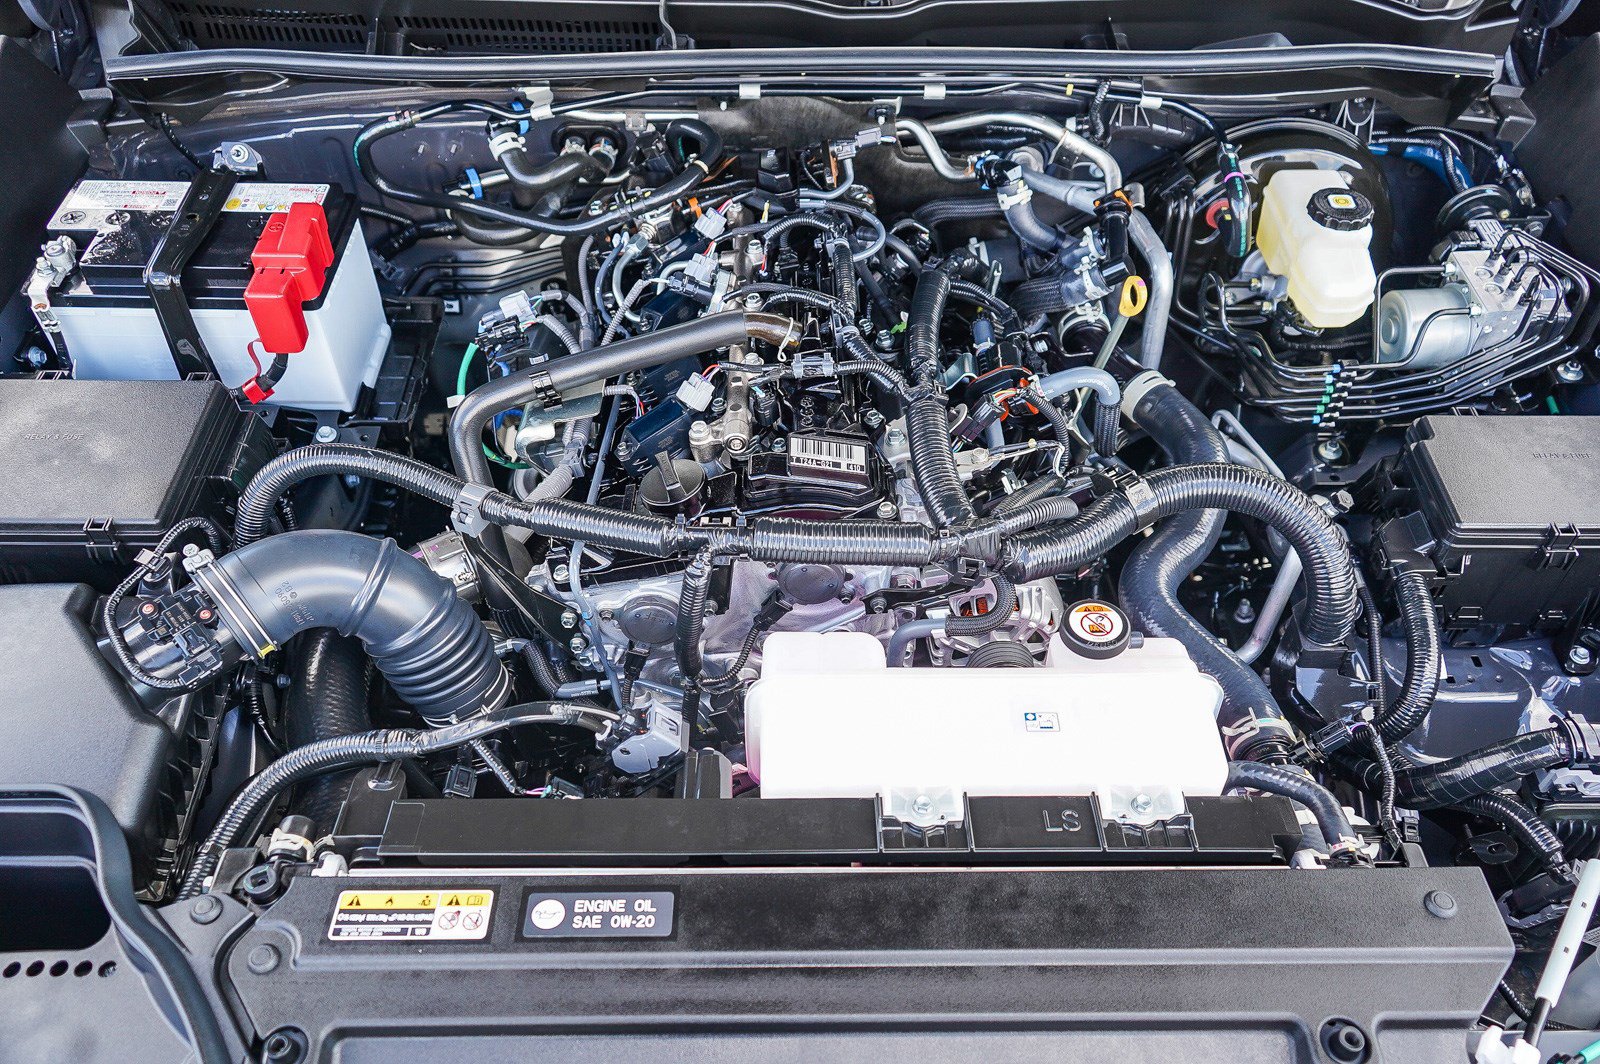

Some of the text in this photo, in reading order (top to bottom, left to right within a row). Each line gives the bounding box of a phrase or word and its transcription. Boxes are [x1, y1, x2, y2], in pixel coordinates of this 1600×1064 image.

[24, 433, 53, 441] RELAY
[62, 433, 86, 441] FUSE
[1042, 810, 1082, 832] LS
[574, 899, 657, 913] ENGINE OIL
[572, 915, 603, 929] SAE
